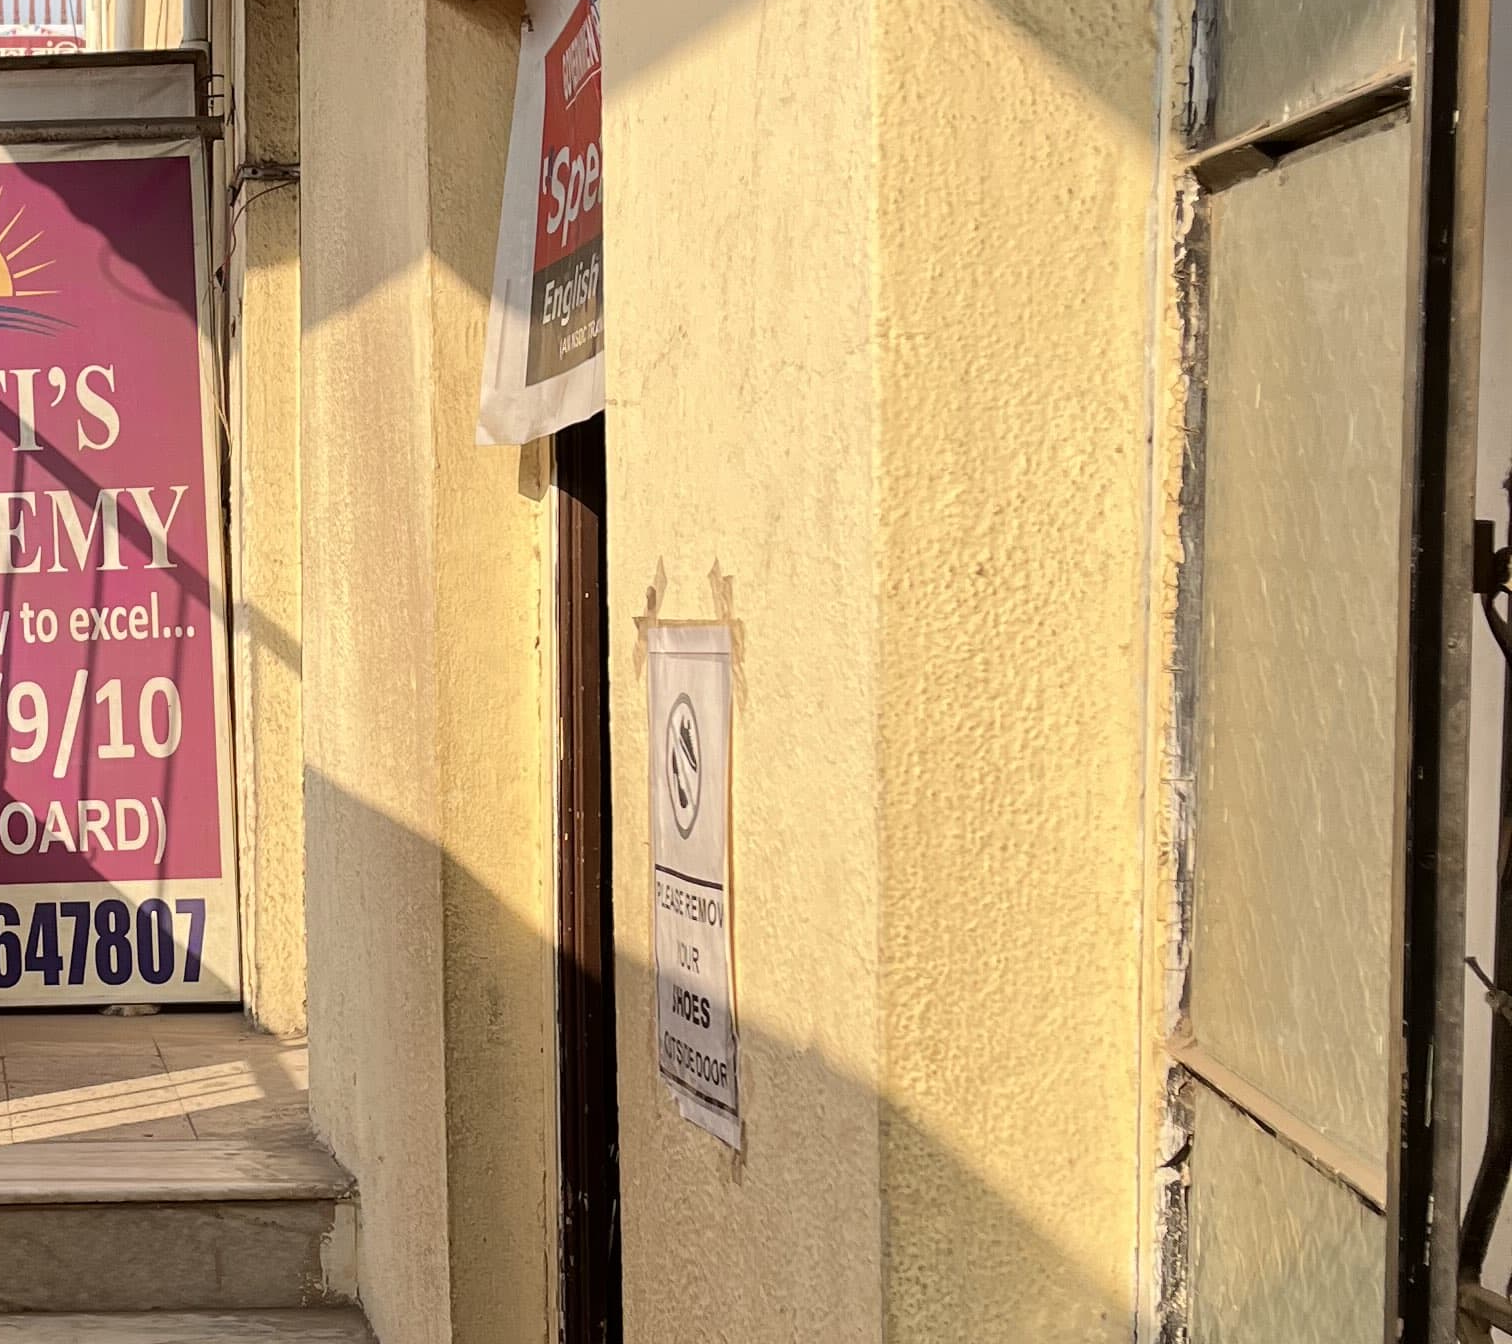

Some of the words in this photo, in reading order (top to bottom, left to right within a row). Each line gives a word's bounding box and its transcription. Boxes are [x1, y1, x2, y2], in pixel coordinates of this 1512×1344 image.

[542, 253, 600, 327] English
[19, 601, 59, 644] to
[696, 1051, 729, 1088] DOOR
